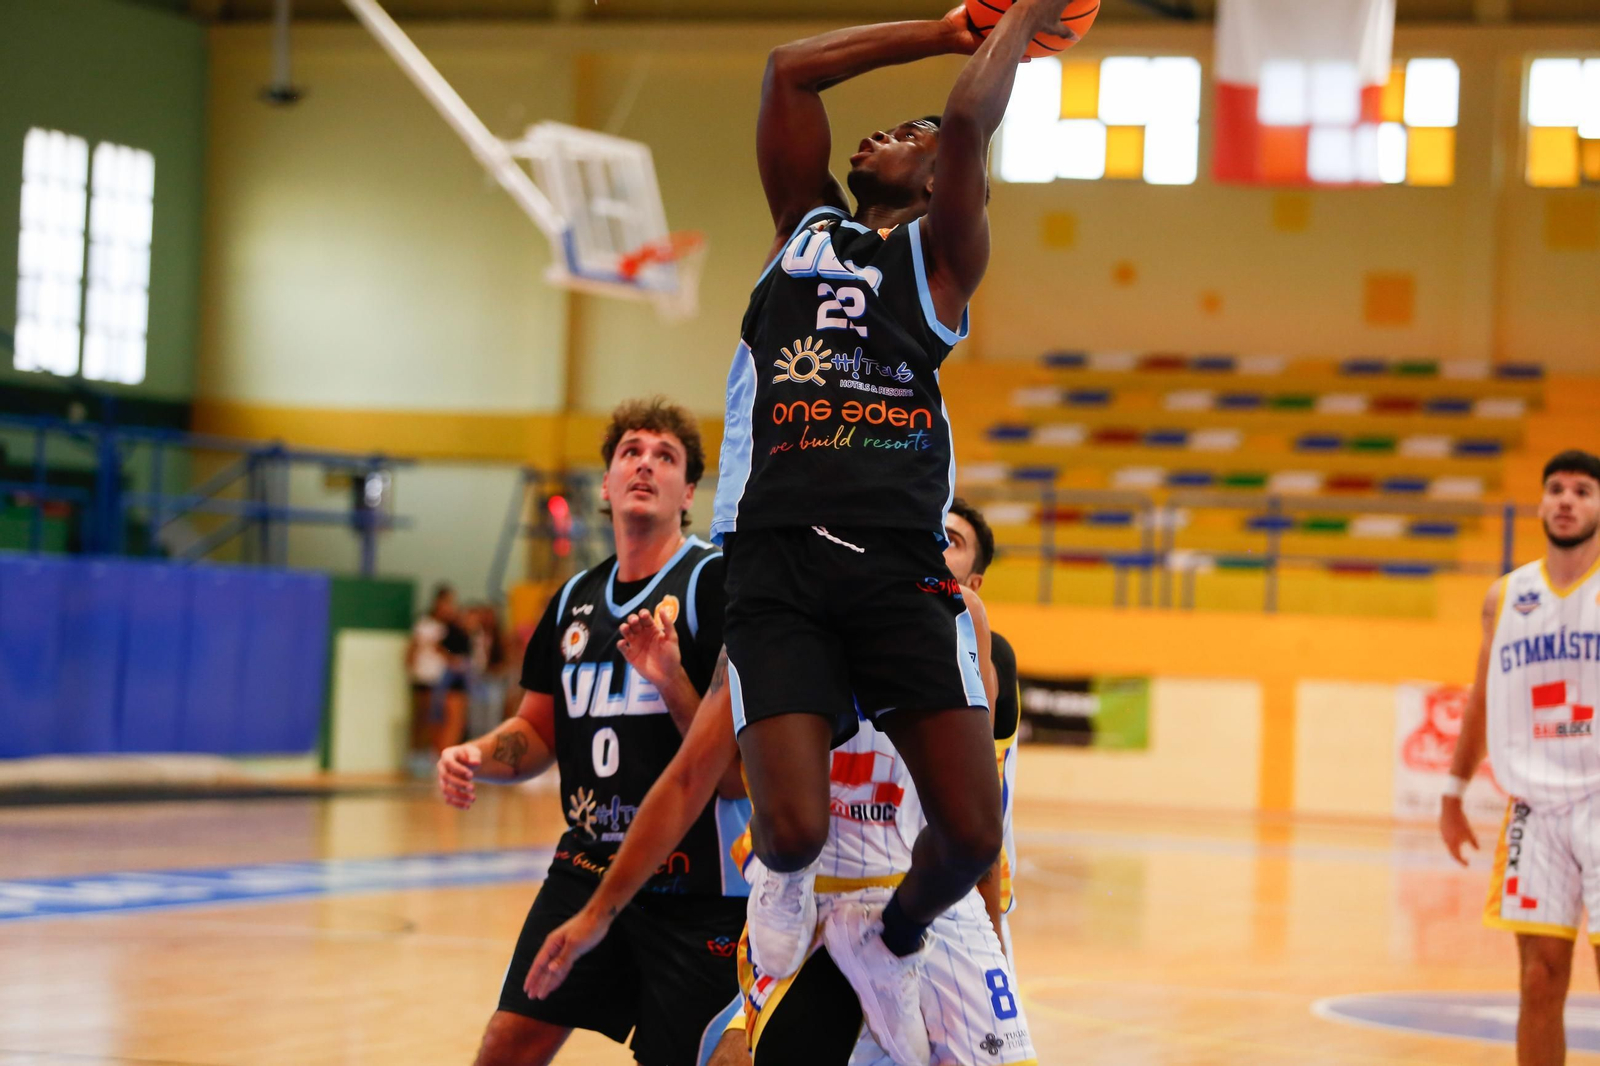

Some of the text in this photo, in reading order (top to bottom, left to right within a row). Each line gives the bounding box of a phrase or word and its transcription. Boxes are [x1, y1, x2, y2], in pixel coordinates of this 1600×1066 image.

[816, 282, 868, 338] 22
[840, 379, 914, 397] HOTELS & RESORTS
[799, 424, 857, 450] build
[863, 429, 932, 451] resorts
[592, 727, 620, 778] 0
[985, 968, 1018, 1021] 8
